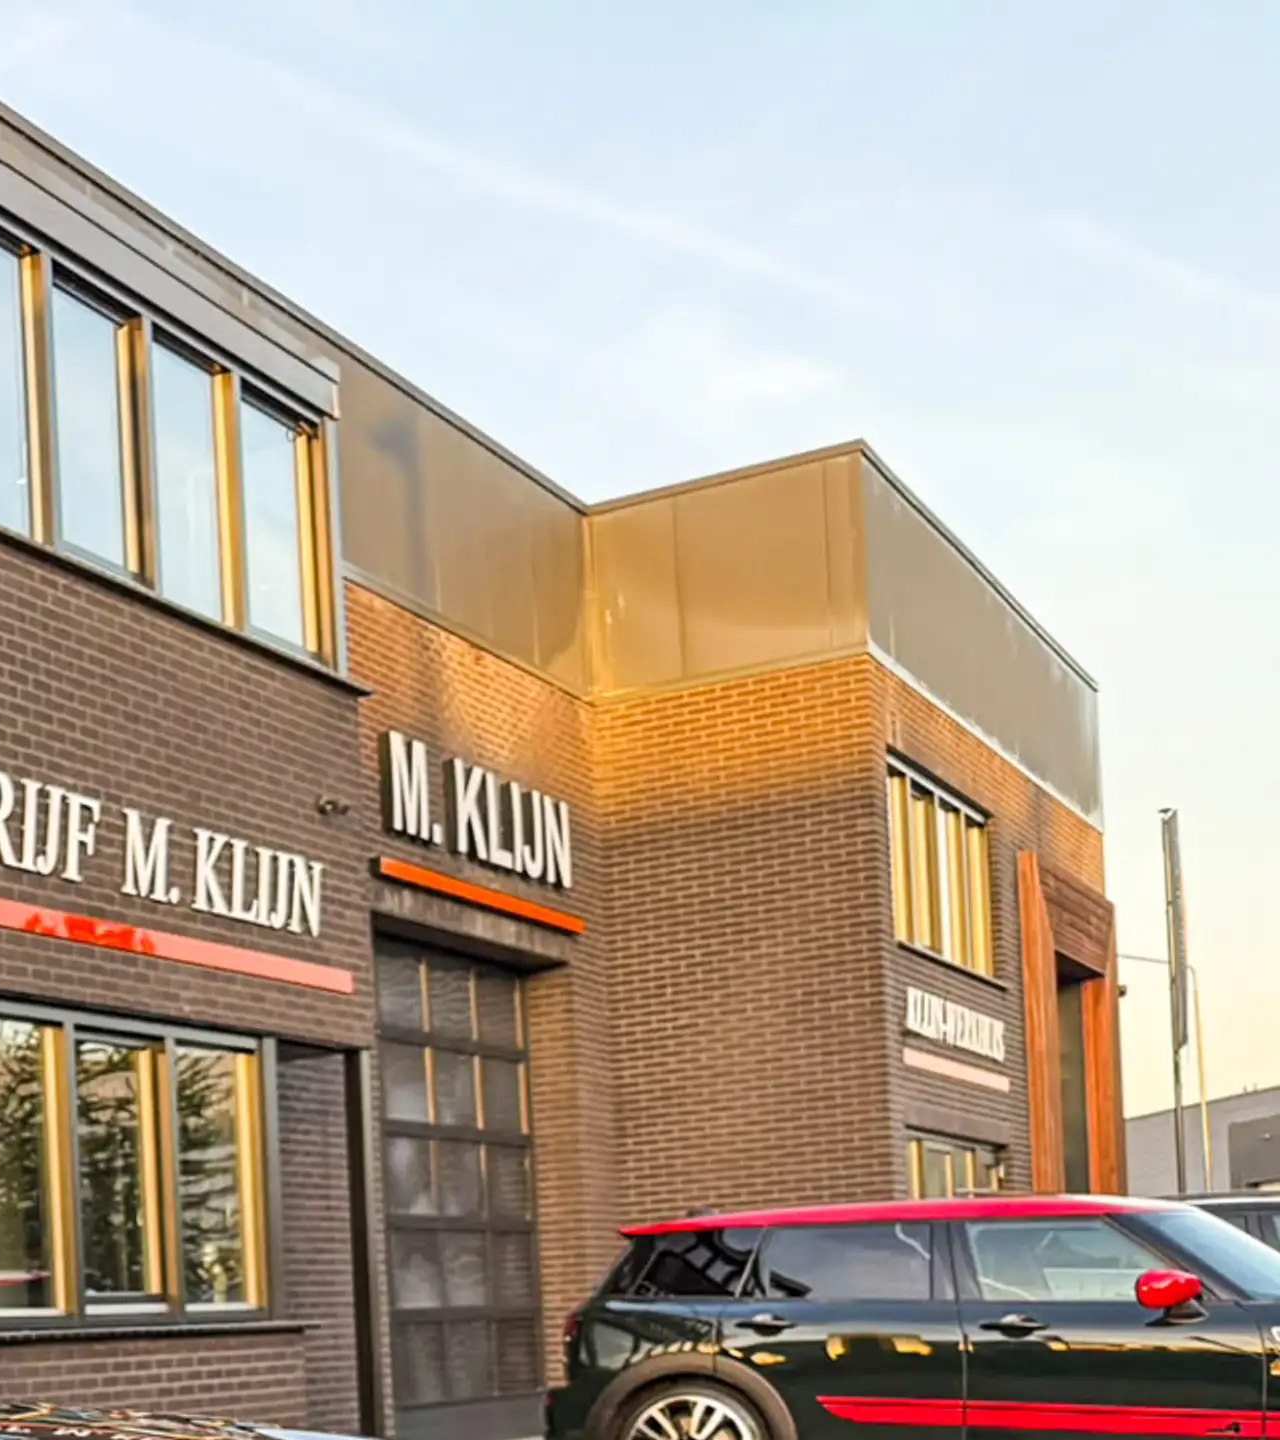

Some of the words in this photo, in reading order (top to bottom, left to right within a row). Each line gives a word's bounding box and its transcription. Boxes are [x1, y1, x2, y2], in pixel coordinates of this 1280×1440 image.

[121, 808, 181, 905] M.
[192, 828, 324, 938] KLIJN
[385, 730, 442, 847] M.
[452, 758, 573, 889] KLIJN
